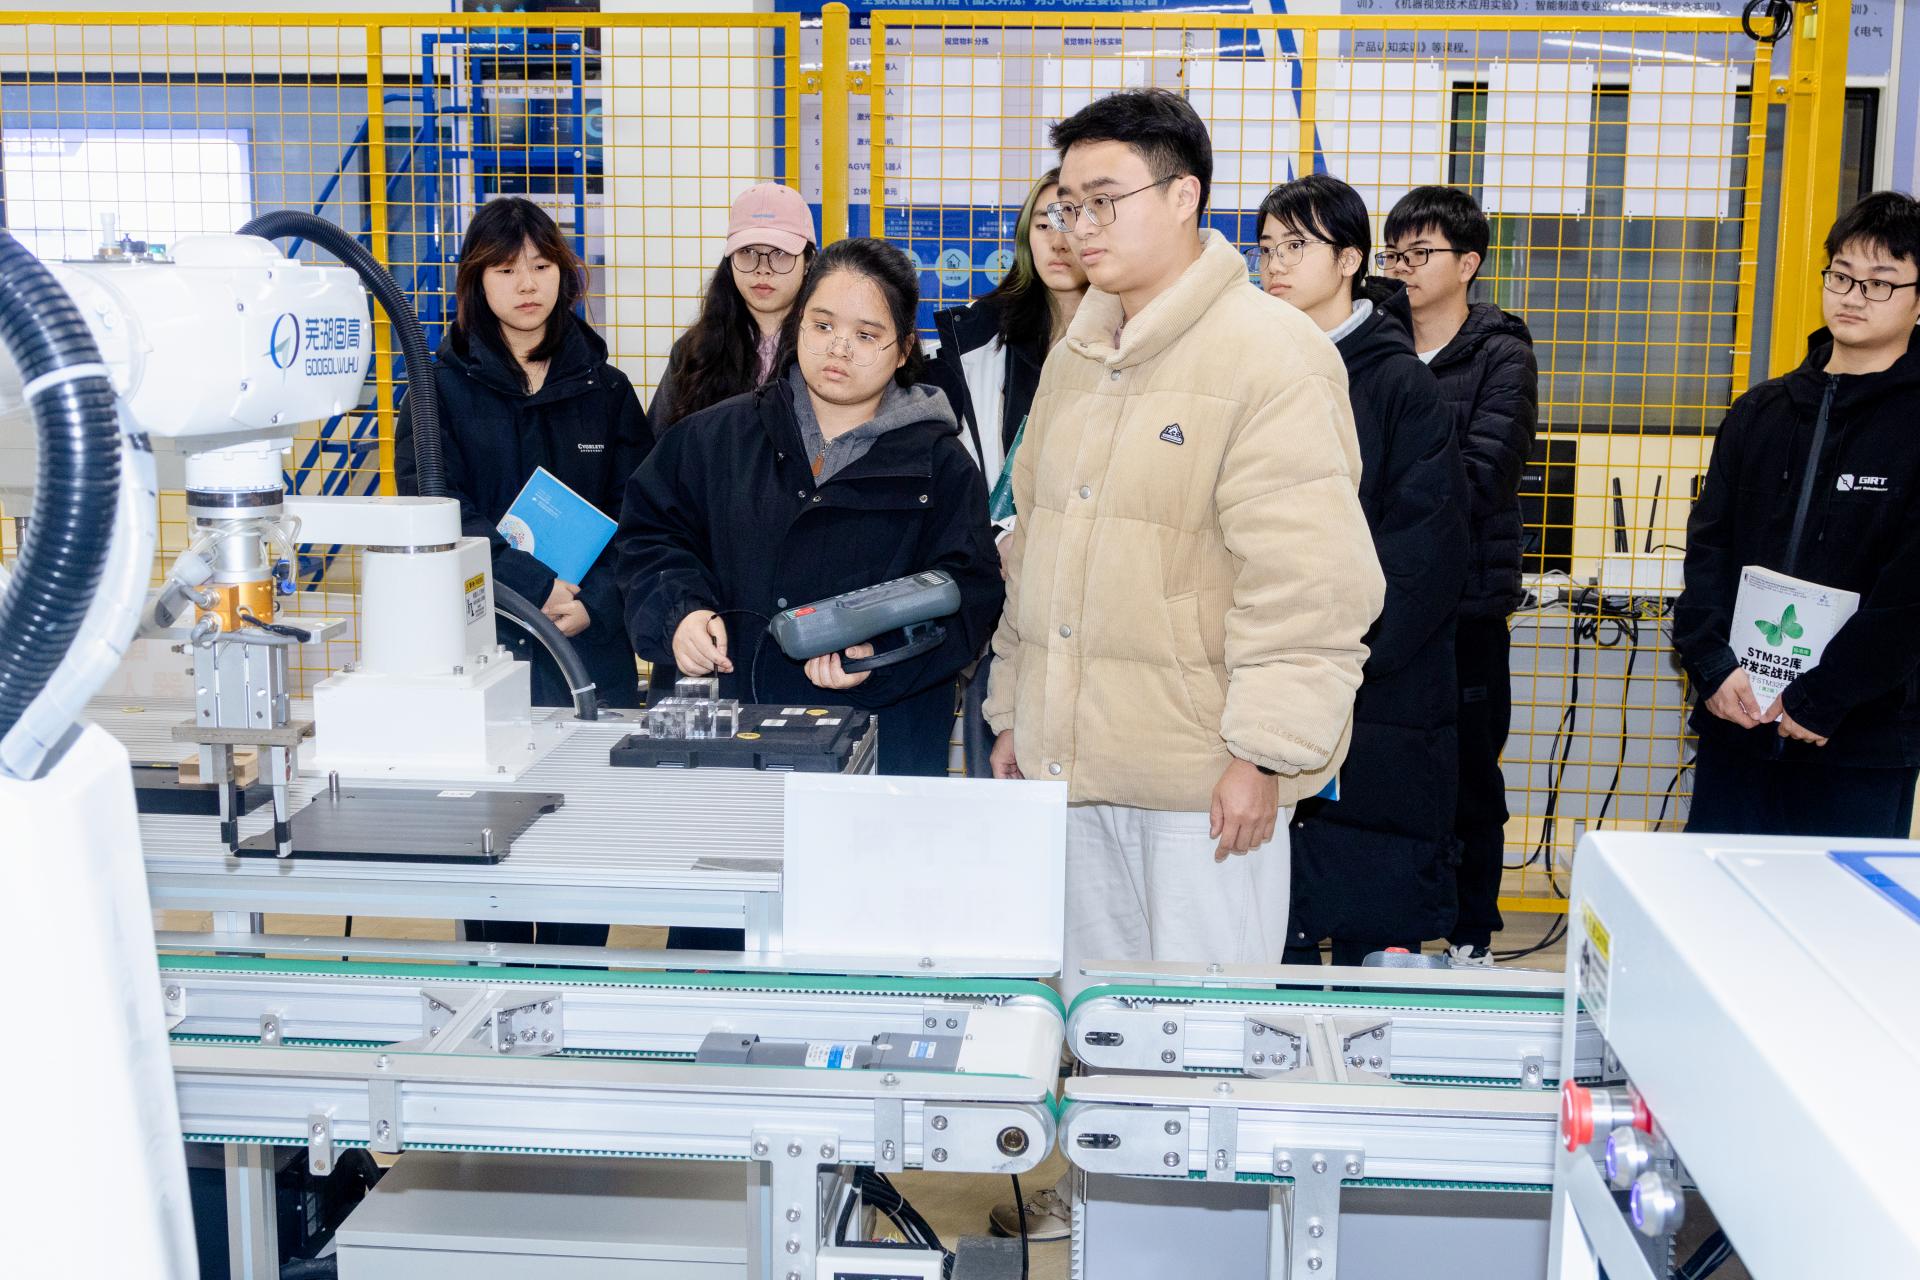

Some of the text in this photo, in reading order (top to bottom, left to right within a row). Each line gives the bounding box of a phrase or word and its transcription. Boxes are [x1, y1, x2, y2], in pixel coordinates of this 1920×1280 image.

[305, 317, 360, 351] 芜湖固高
[1747, 646, 1803, 670] STM32库
